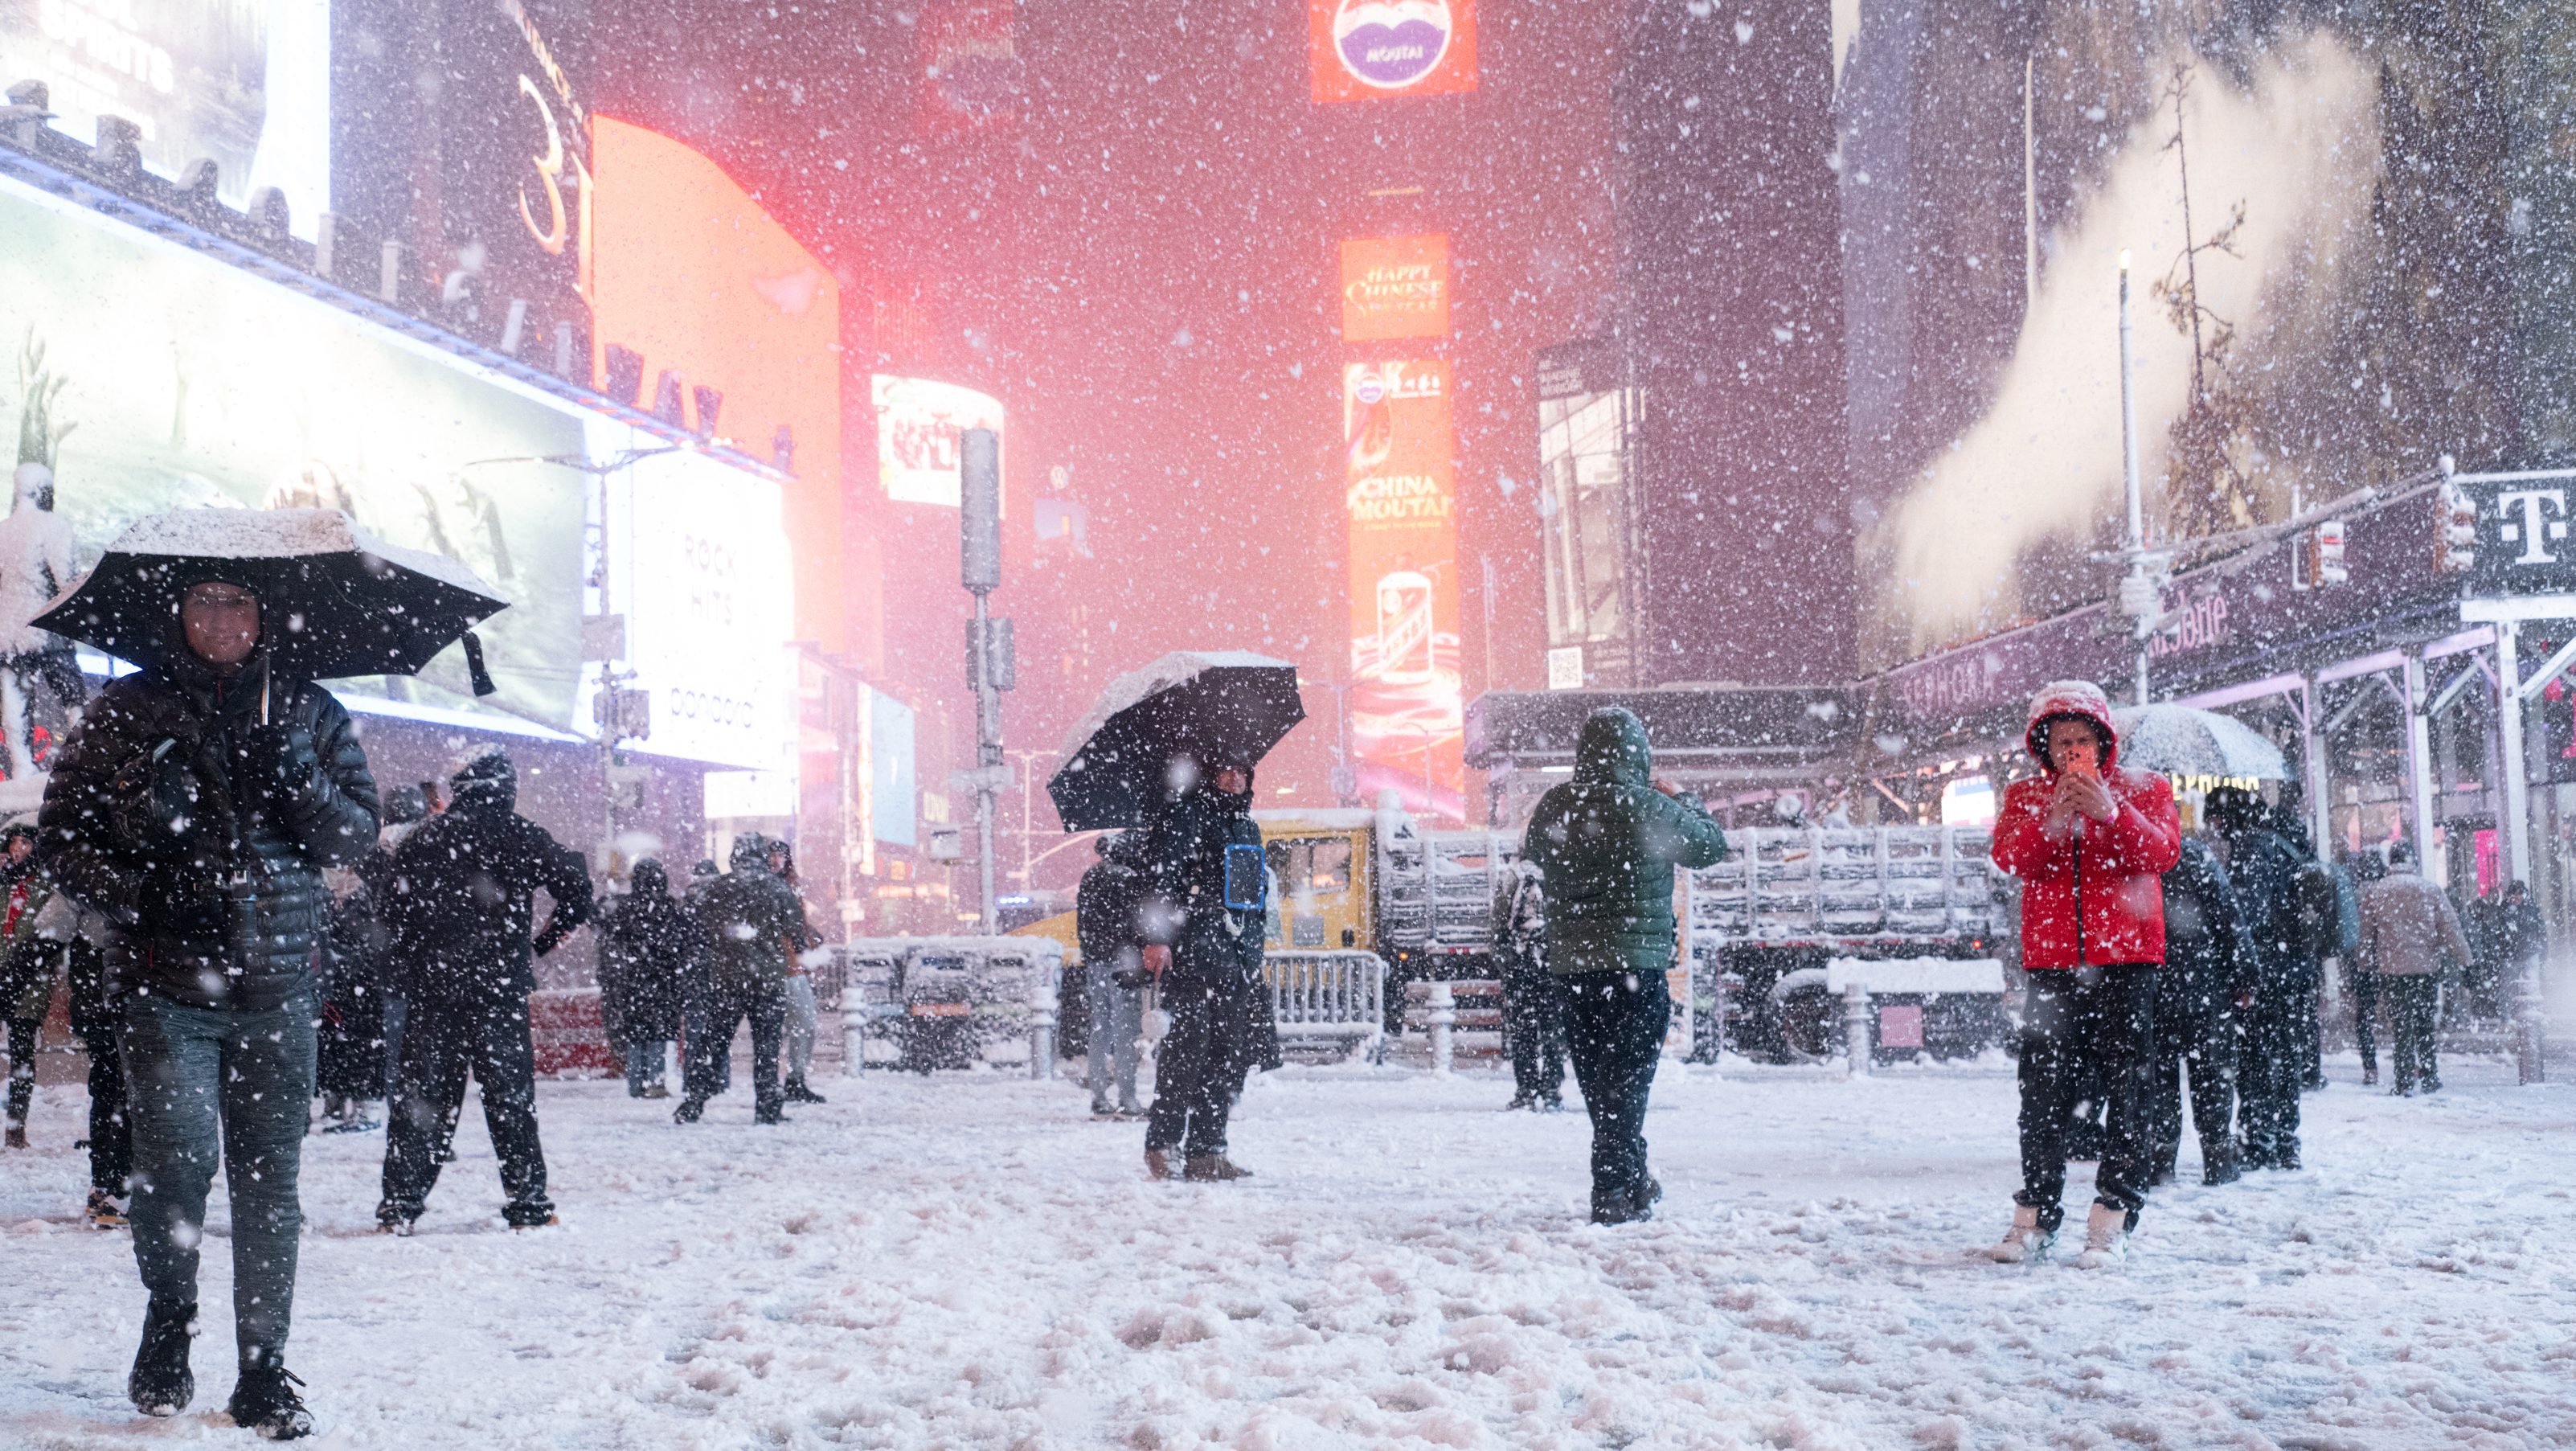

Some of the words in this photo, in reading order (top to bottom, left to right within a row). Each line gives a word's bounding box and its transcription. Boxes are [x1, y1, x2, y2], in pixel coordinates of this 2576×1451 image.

[43, 0, 174, 94] SPIRITS
[1366, 44, 1424, 64] MOUTAI
[1366, 264, 1433, 284] HAPPY
[1345, 280, 1444, 315] CHINESE
[1360, 474, 1439, 500] CHINA
[1352, 494, 1450, 523] MOUTAI
[2498, 489, 2567, 565] T
[685, 532, 738, 582] ROCK
[690, 583, 733, 628] HITS
[1902, 654, 1995, 720] SEPHORA
